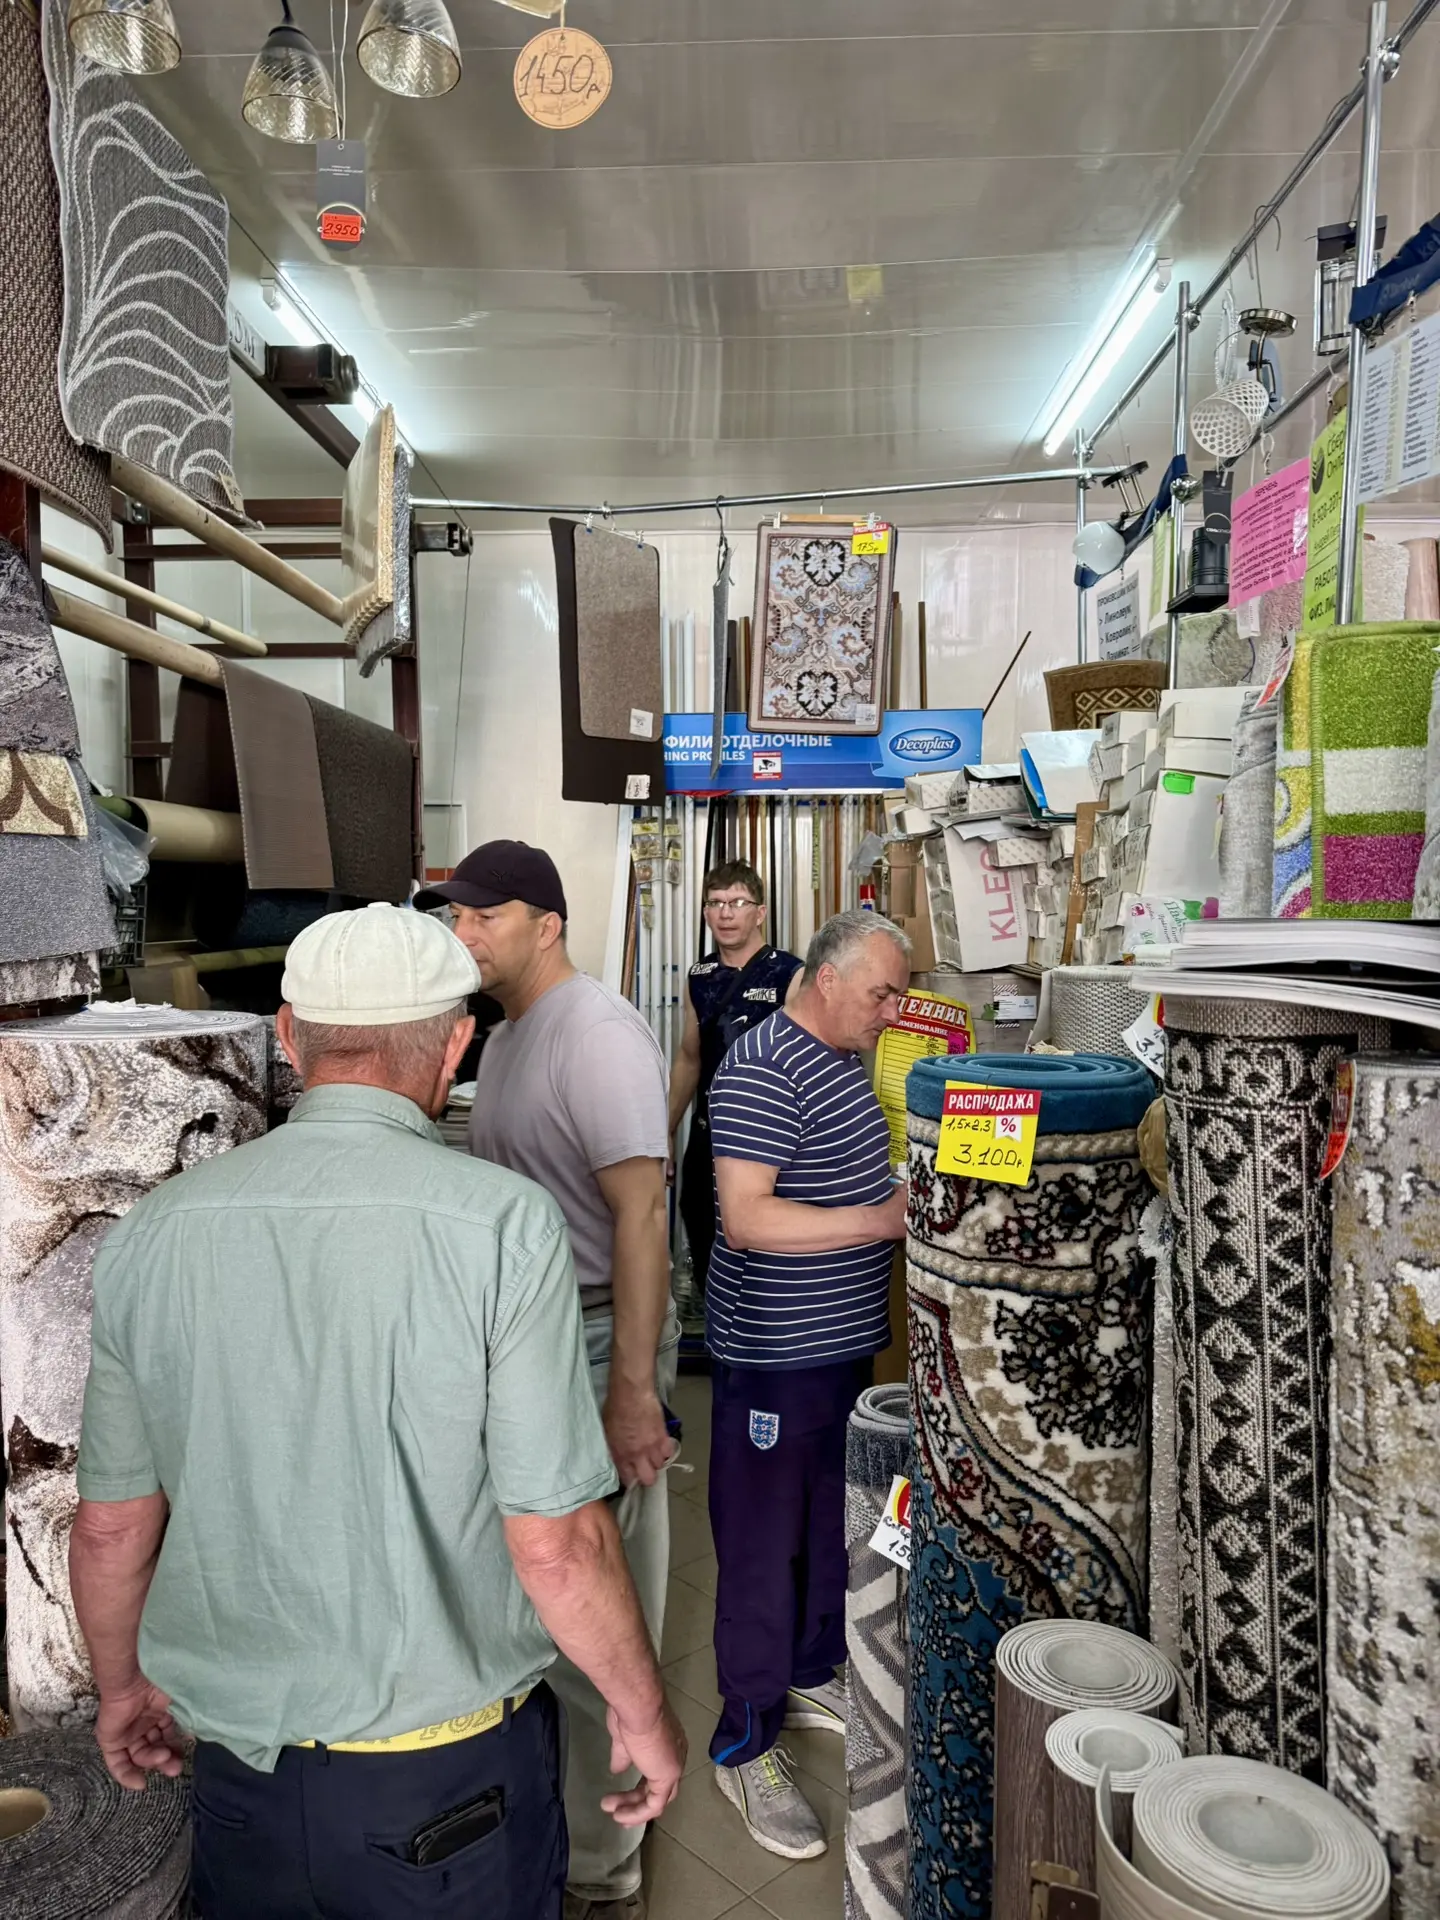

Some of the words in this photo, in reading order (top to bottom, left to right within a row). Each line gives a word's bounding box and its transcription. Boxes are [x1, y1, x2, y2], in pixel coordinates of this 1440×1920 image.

[664, 734, 714, 749] ФИЛИ
[895, 736, 956, 754] Decoplast
[692, 751, 746, 762] PROILES
[899, 1019, 950, 1037] ИМЕНОВАНИЕ
[948, 1093, 1034, 1112] РАСПРОДАЖА
